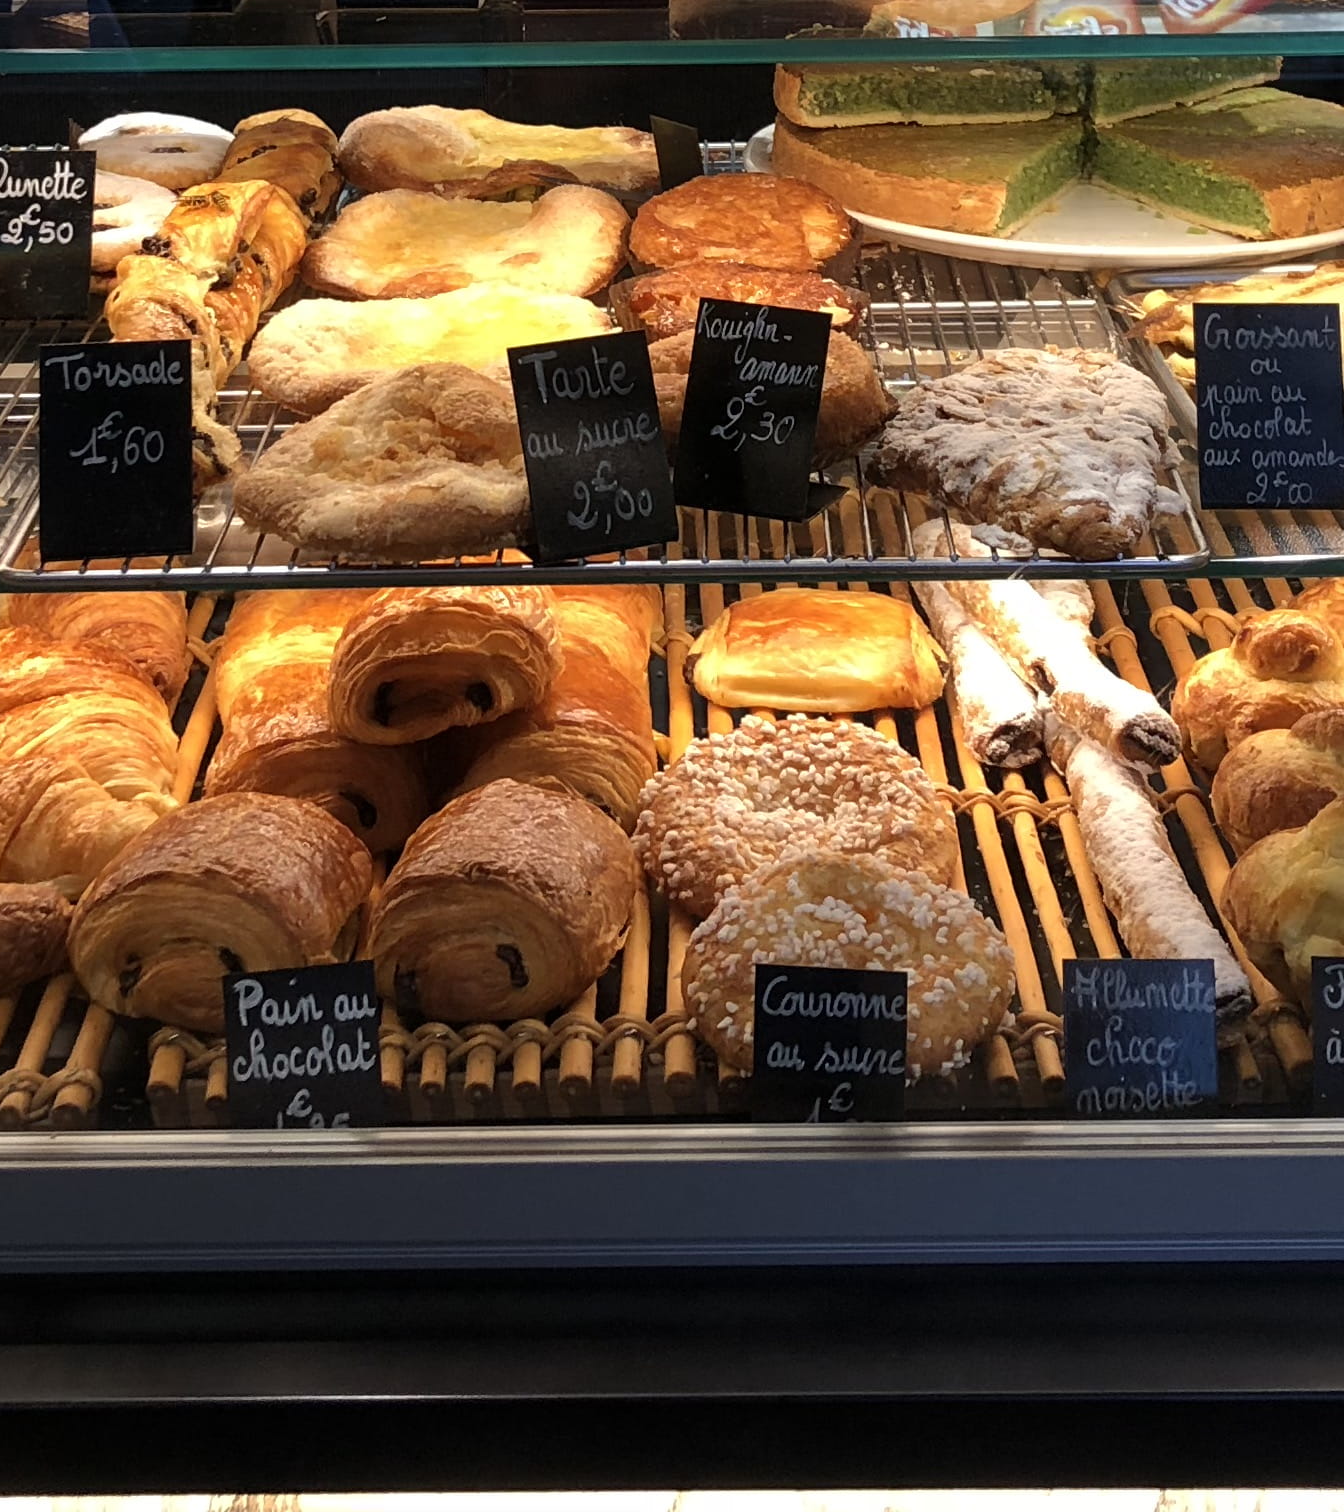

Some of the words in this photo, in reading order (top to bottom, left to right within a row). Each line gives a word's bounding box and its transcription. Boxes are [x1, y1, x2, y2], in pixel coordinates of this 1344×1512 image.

[1204, 313, 1336, 350] Croissant
[45, 349, 184, 391] Torsade
[518, 346, 634, 405] Tarte
[1250, 358, 1282, 375] ou
[1201, 379, 1262, 416] pain
[1272, 386, 1306, 403] au
[527, 431, 563, 459] au
[575, 412, 658, 456] sucre
[1209, 406, 1312, 440] chocolat
[1204, 448, 1240, 466] aux
[233, 978, 323, 1026] Pain
[334, 994, 376, 1021] au
[762, 977, 906, 1020] Couronne
[1071, 967, 1215, 1013] Allumette
[233, 1024, 376, 1082] chocolat
[767, 1042, 804, 1070] au
[814, 1040, 905, 1073] sucre
[1086, 1016, 1177, 1067] choco
[1076, 1076, 1202, 1114] noisette
